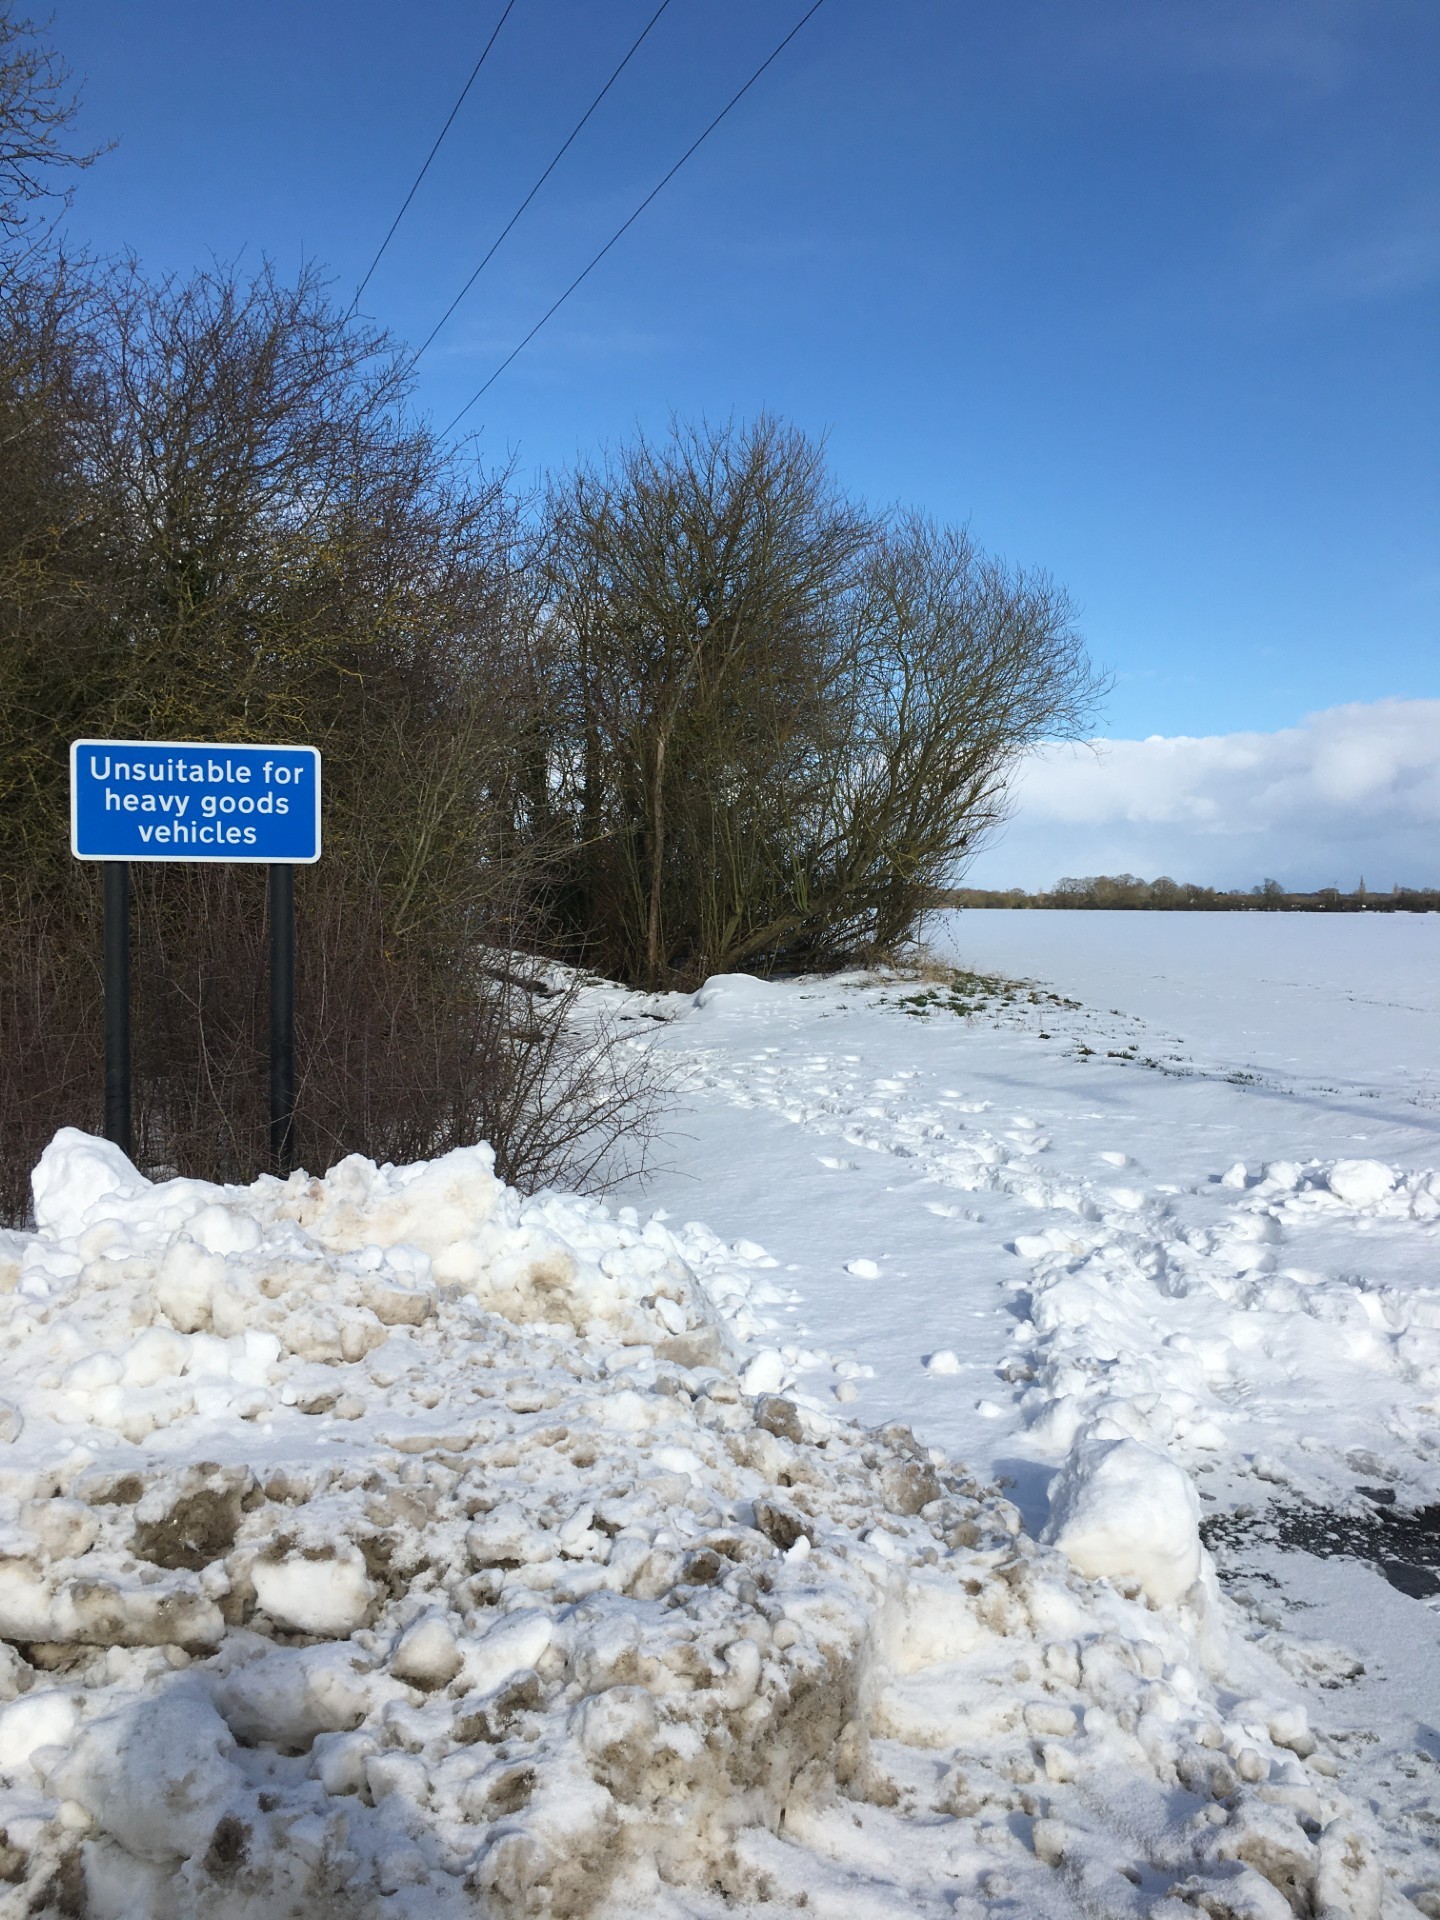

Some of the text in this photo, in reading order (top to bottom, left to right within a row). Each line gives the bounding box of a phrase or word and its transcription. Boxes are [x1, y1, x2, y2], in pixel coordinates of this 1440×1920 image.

[90, 756, 304, 785] Unsuitable for
[105, 787, 290, 818] heavy goods
[138, 820, 257, 844] vehicles
